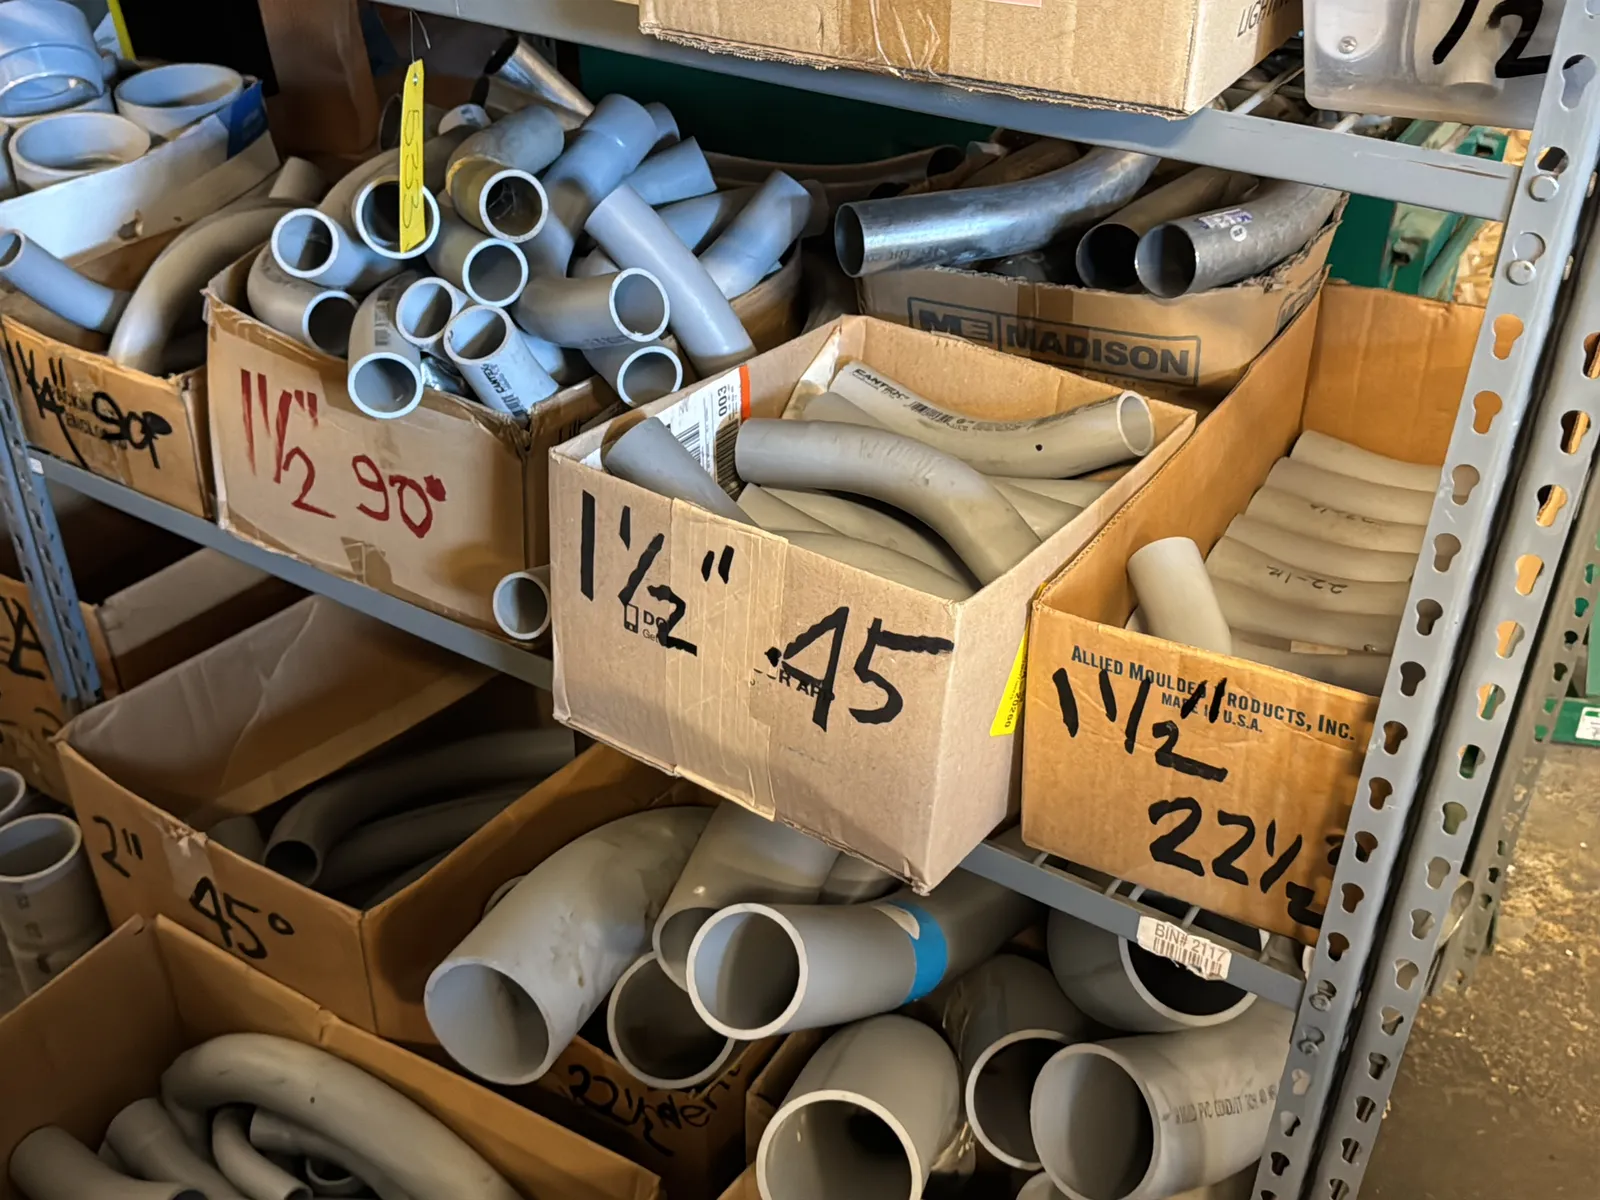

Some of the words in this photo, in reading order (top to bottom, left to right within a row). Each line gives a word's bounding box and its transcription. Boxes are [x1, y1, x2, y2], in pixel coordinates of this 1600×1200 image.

[1006, 323, 1191, 377] MADISON
[1071, 645, 1124, 676] ALLIED
[1214, 685, 1312, 732] RODUCTS,
[1317, 713, 1356, 741] INC.
[1223, 709, 1263, 733] U.S.A.
[1154, 923, 1188, 946] BIN#
[1190, 939, 1229, 962] 2117
